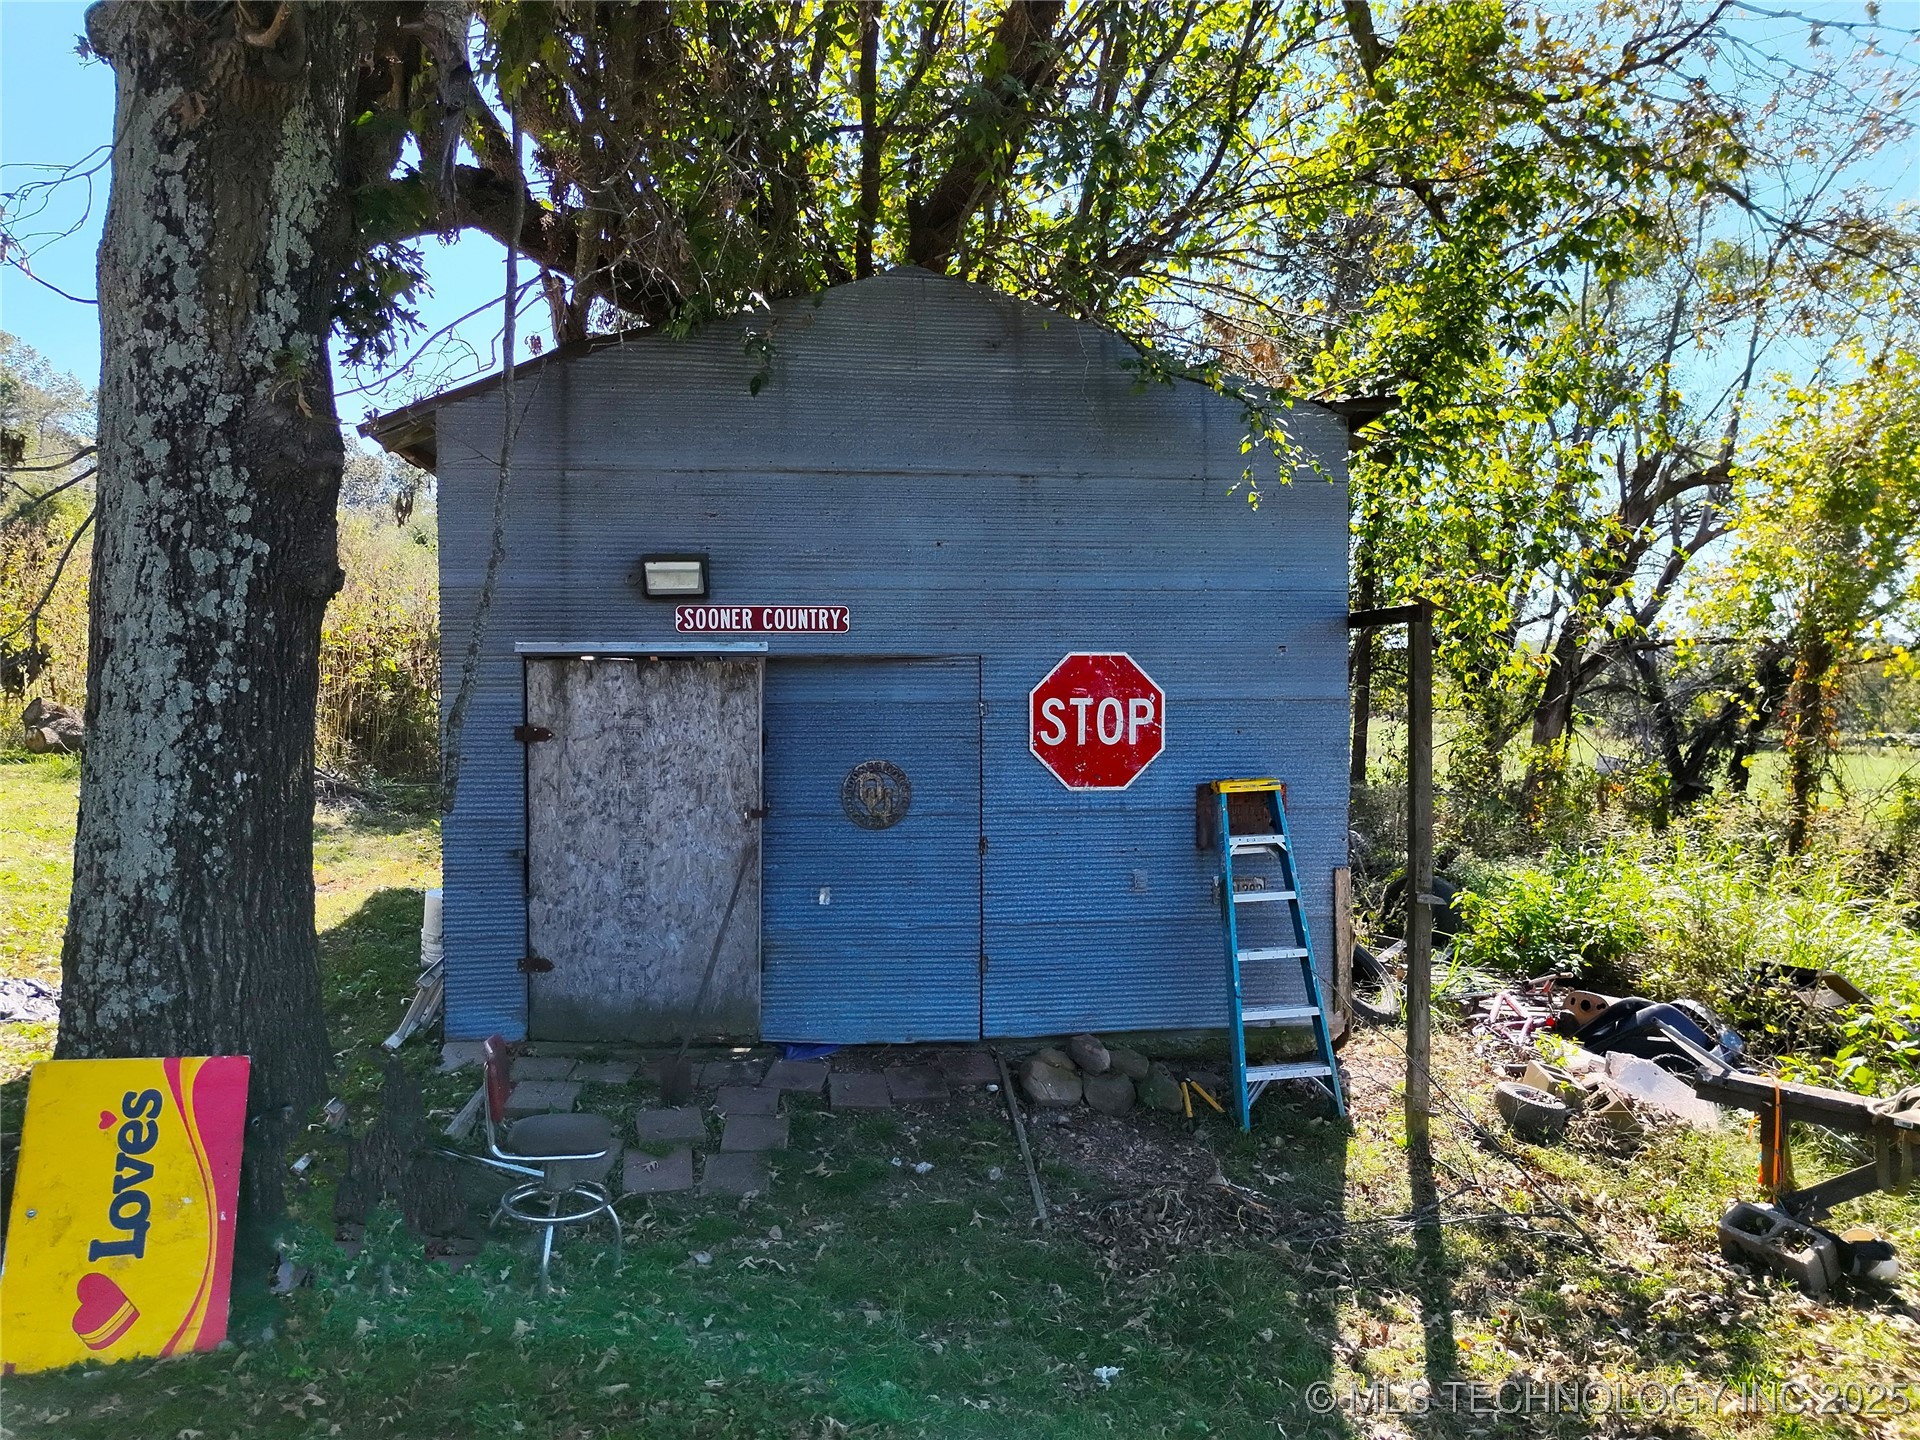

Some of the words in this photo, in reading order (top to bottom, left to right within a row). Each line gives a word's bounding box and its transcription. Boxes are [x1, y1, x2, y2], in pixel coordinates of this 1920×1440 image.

[684, 608, 752, 630] SOONER
[763, 608, 841, 630] COUNTRY
[1040, 697, 1155, 746] STOP
